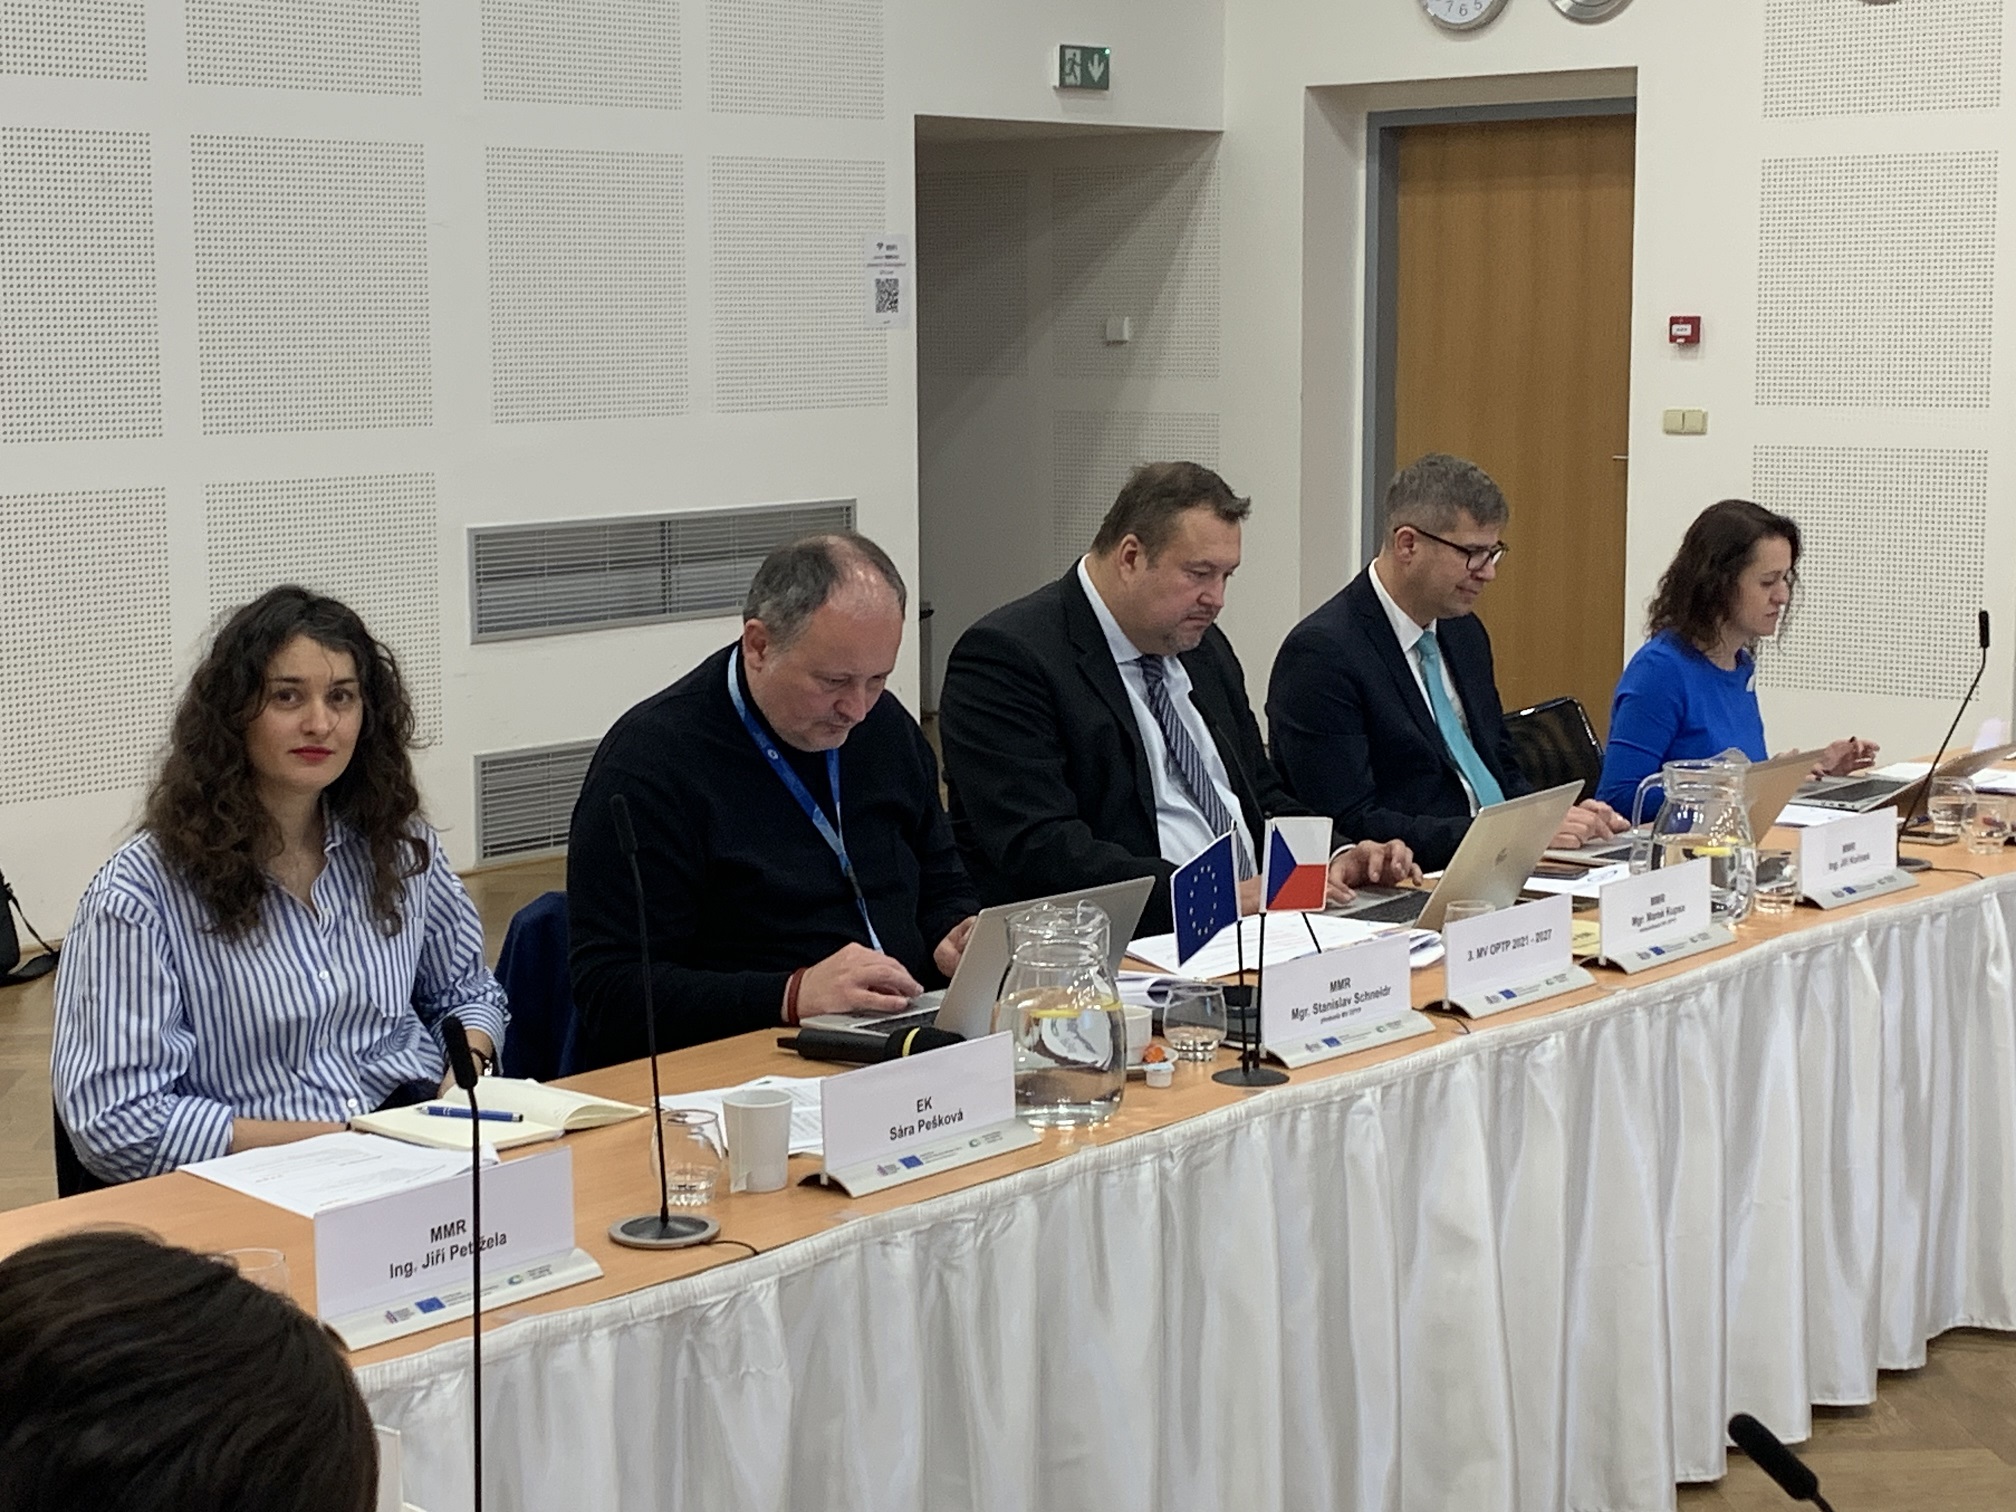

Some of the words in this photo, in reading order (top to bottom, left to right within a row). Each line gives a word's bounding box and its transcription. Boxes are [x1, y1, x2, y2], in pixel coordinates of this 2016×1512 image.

[1445, 0, 1453, 12] 7
[1459, 4, 1468, 16] 6
[1474, 0, 1482, 10] 5
[1476, 945, 1488, 958] MV
[1490, 940, 1511, 956] OPTP
[1512, 935, 1529, 949] 2021
[1536, 929, 1552, 943] 2027
[1330, 977, 1351, 993] MMR
[1291, 1006, 1310, 1021] Mgr.
[1313, 996, 1352, 1015] Stanislav
[1354, 985, 1391, 1004] Schneidr
[917, 1097, 933, 1113] EK
[890, 1122, 914, 1141] Sára
[918, 1108, 964, 1133] Pešková
[430, 1219, 466, 1243] MMR
[389, 1261, 417, 1279] Ing.
[422, 1245, 446, 1269] Jiří
[450, 1231, 507, 1258] Petžela
